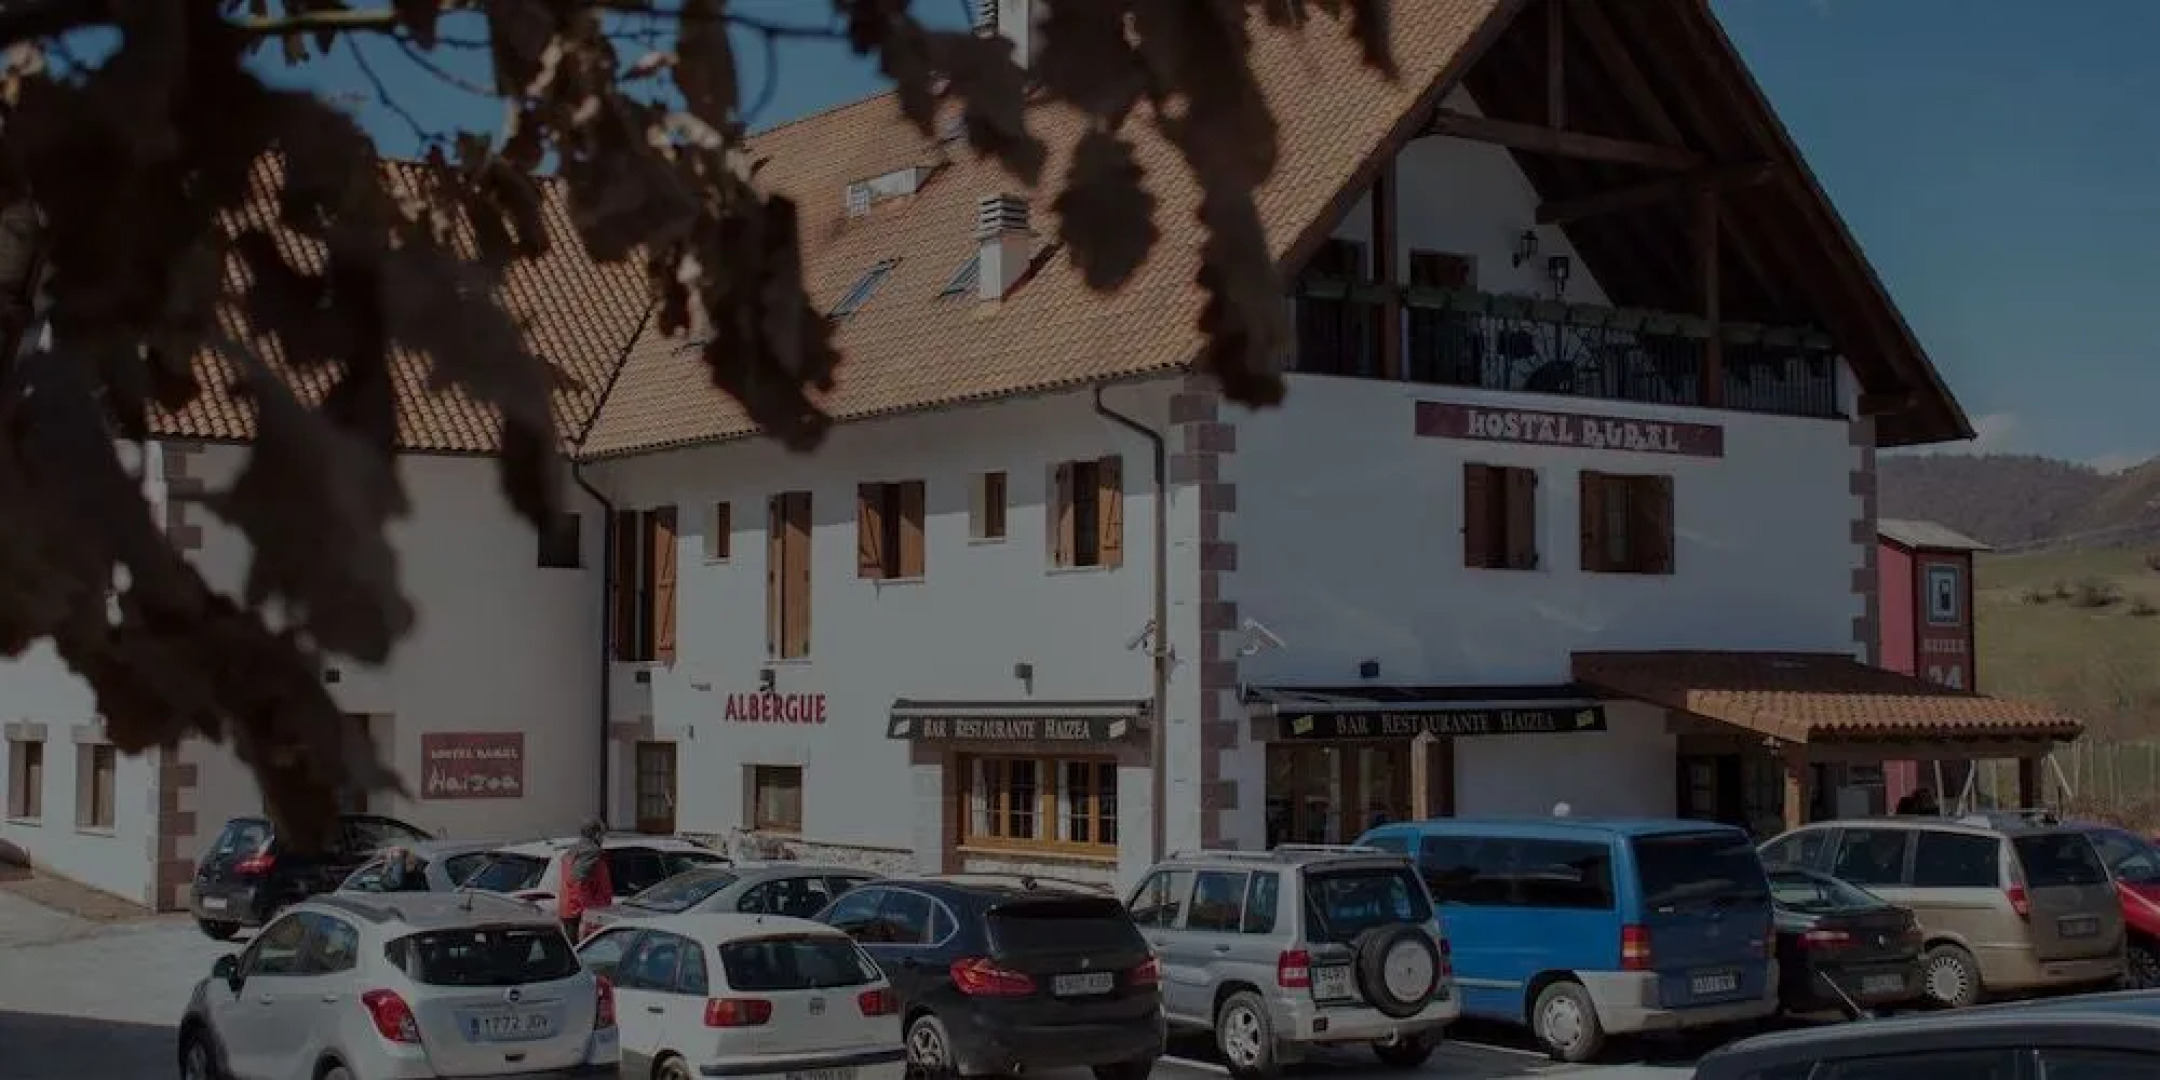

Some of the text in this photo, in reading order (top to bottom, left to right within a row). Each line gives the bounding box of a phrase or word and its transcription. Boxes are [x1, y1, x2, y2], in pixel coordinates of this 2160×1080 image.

[1467, 409, 1681, 451] HOSTAL RURAL
[724, 692, 828, 724] ALBERGUE
[923, 718, 1091, 739] BAR RESTAURANTE HAIZEA
[1336, 713, 1368, 735] BAR
[1381, 713, 1489, 735] RESTAURANTE
